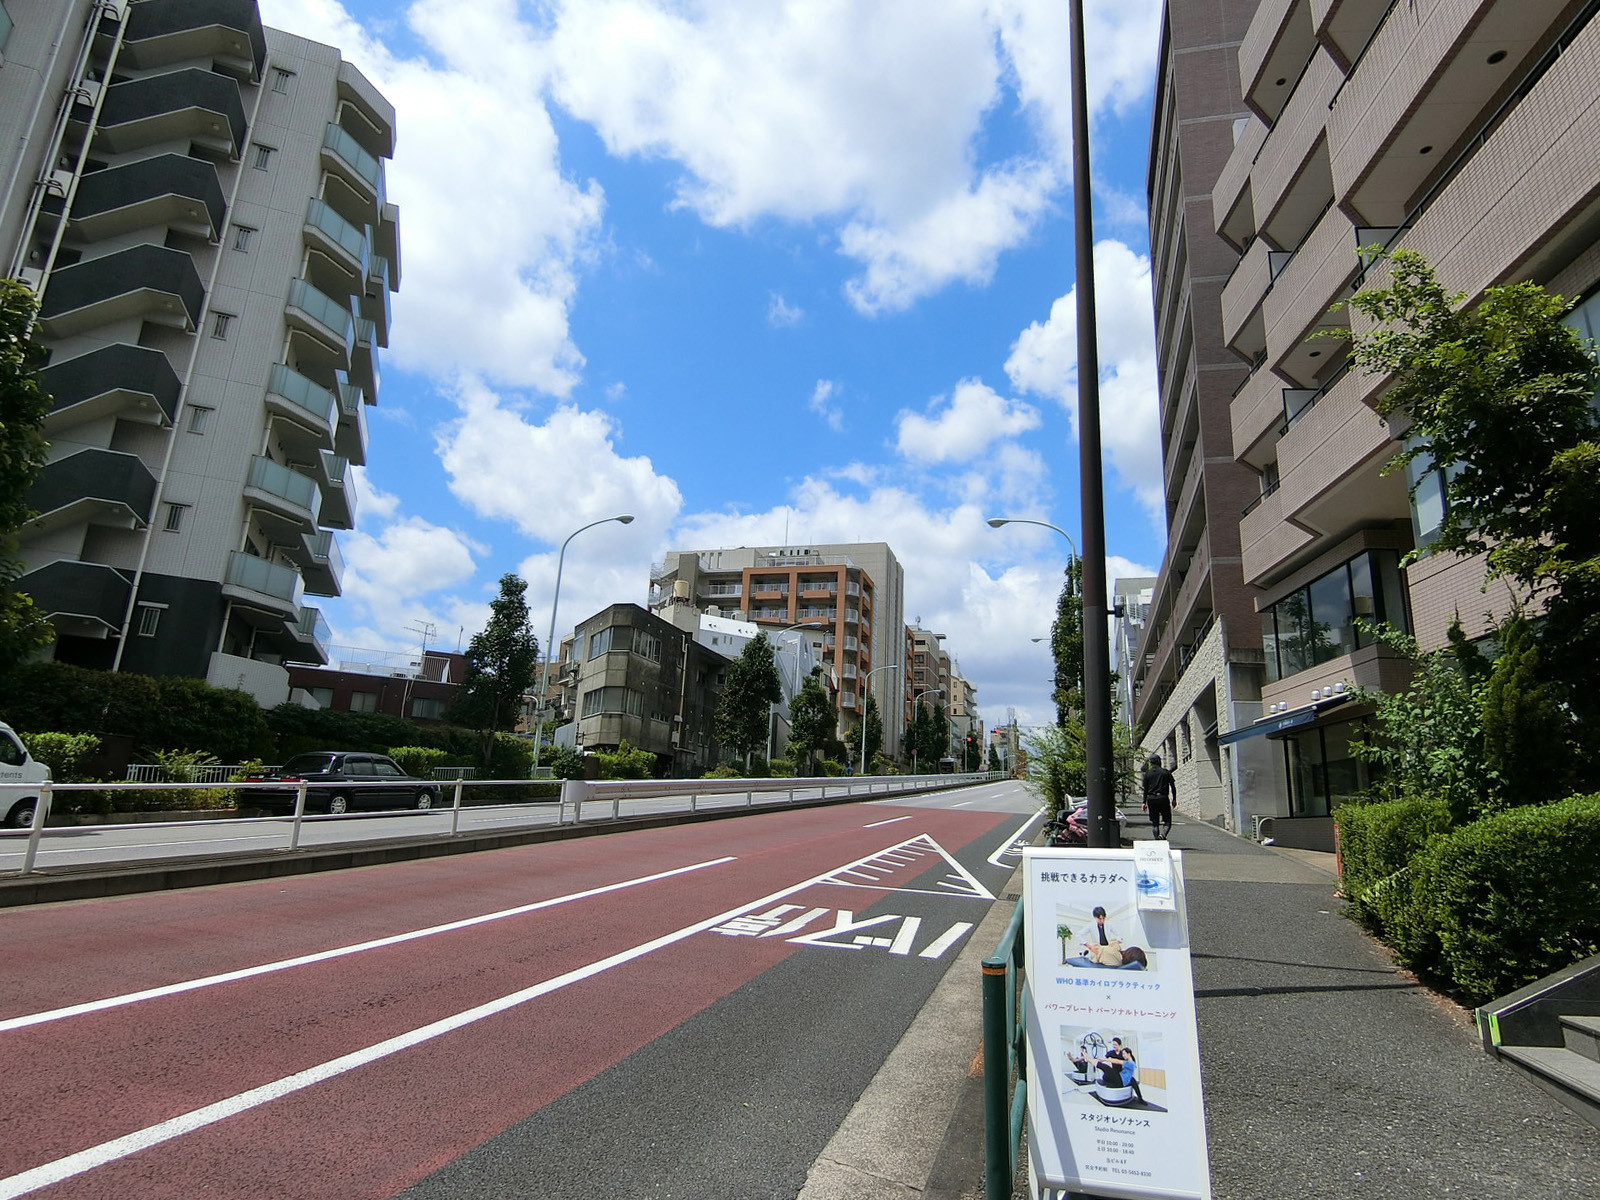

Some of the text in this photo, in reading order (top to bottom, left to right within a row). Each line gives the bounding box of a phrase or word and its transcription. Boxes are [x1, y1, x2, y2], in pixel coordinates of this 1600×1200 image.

[1041, 871, 1128, 884] 挑戦できるカラダへ
[1055, 977, 1074, 985] WHO
[1080, 1113, 1150, 1127] スタジオレゾナンス
